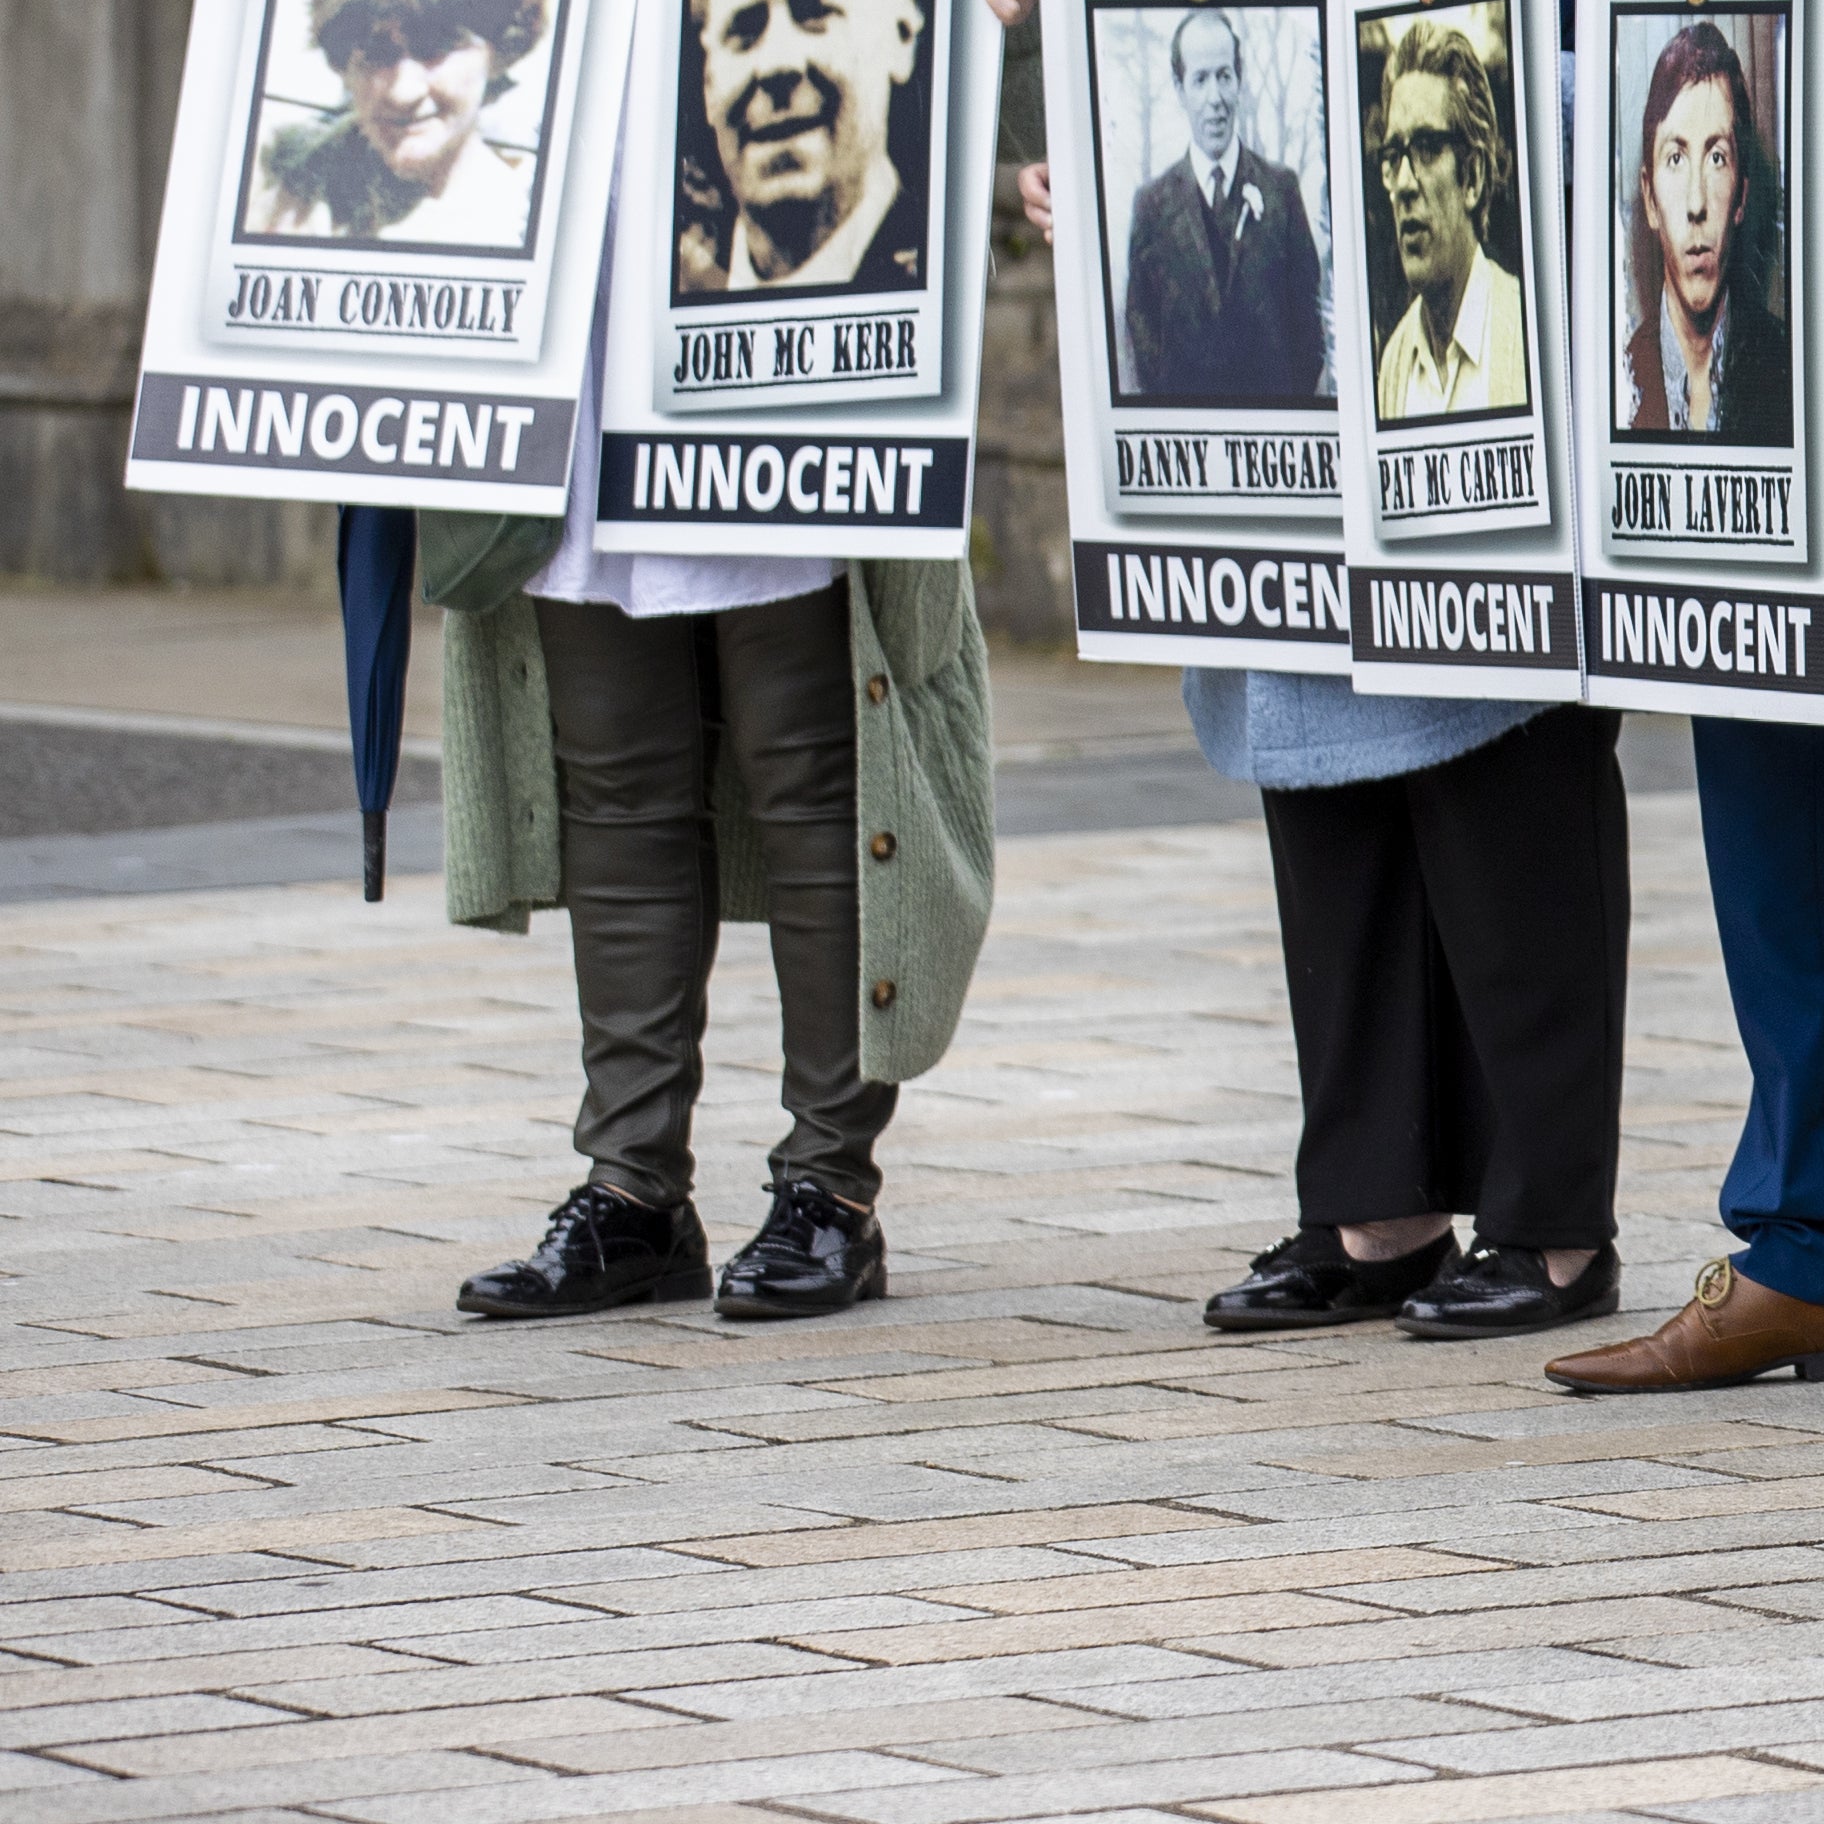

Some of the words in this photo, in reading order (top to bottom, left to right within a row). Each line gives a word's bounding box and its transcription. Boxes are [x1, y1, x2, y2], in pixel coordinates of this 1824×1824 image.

[229, 272, 321, 322] JOAN
[340, 279, 522, 332] CONNOLLY
[674, 330, 755, 383] JOHN
[773, 325, 814, 374] MC
[833, 318, 916, 373] KERR
[177, 386, 535, 471] INNOCENT
[635, 444, 932, 513] INNOCENT
[1116, 438, 1208, 487] DANNY
[1226, 440, 1341, 489] TEGGAR
[1378, 454, 1414, 511] PAT
[1428, 452, 1450, 507] MC
[1461, 443, 1535, 499] CARTHY
[1612, 472, 1671, 531] JOHN
[1685, 474, 1791, 535] LAVERTY
[1107, 553, 1350, 630] INNOCEN
[1370, 578, 1555, 658] INNOCENT
[1601, 591, 1812, 678] INNOCENT
